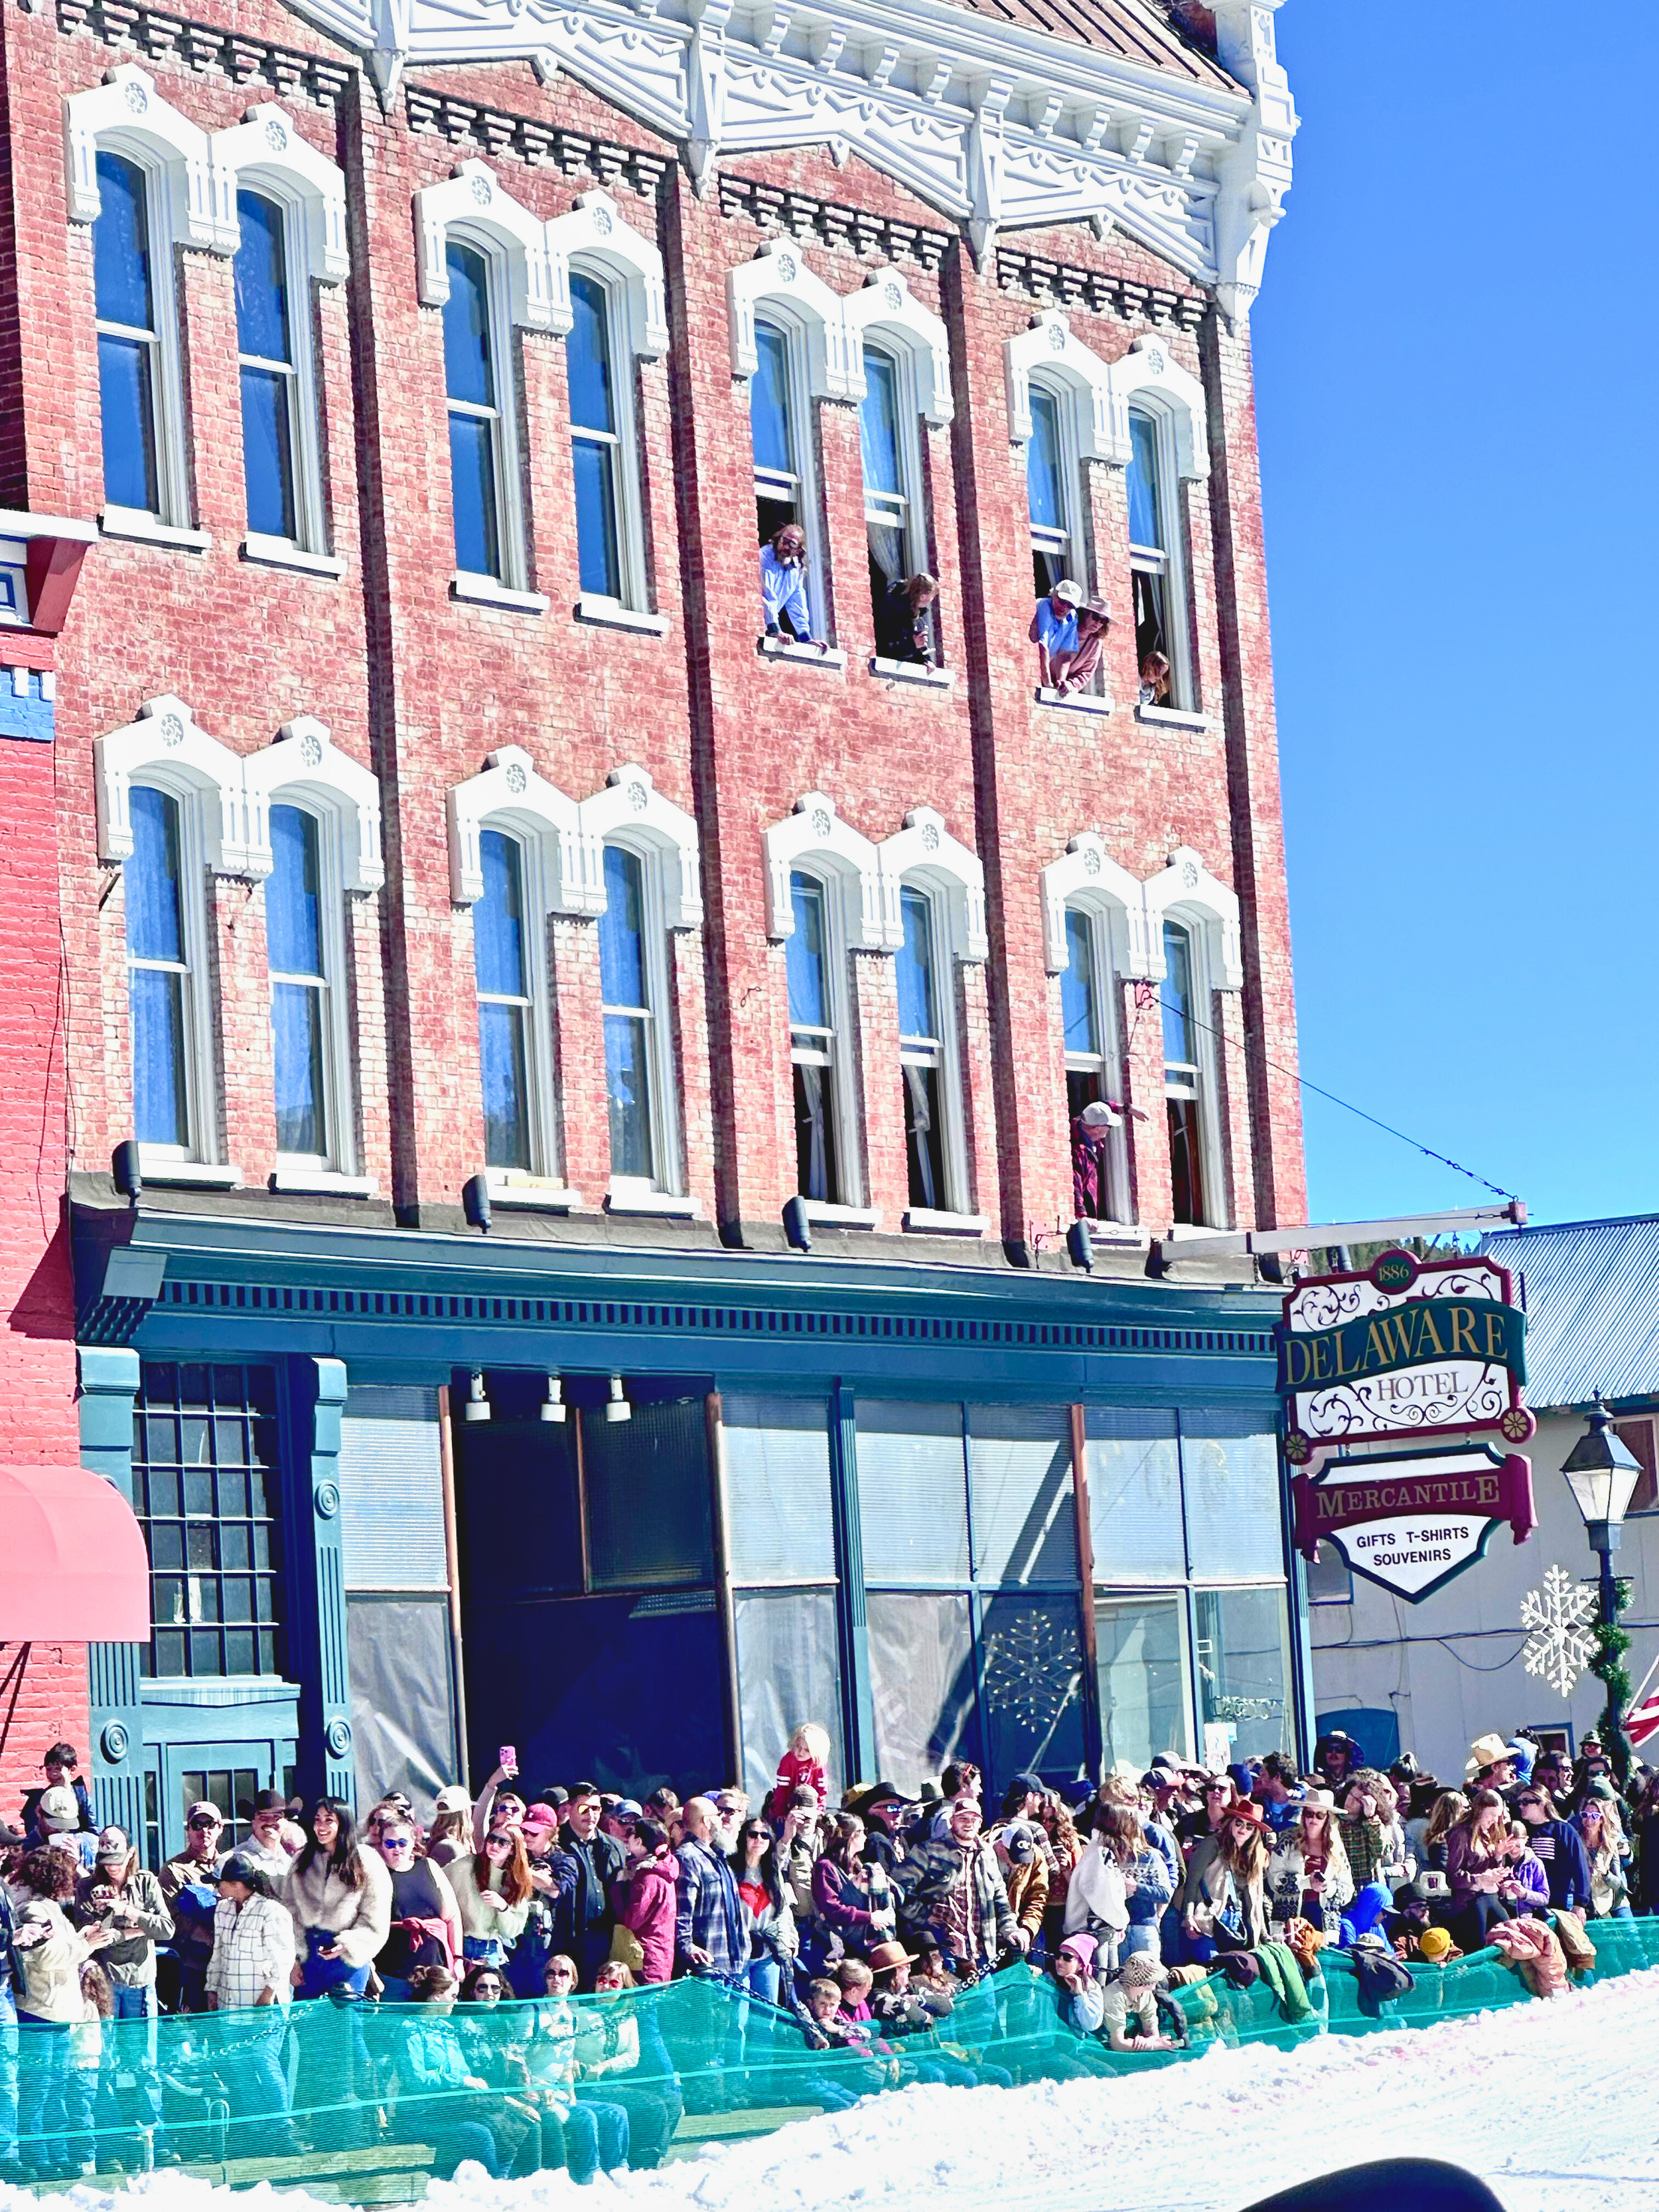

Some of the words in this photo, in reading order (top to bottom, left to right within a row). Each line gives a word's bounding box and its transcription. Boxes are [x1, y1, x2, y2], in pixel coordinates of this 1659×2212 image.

[1378, 1264, 1409, 1282] 1886
[1284, 1307, 1508, 1384] DELAWARE
[1376, 1372, 1469, 1401] HOTEL
[1316, 1476, 1500, 1518] MERCANTILE
[1356, 1533, 1396, 1548] GIFTS
[1406, 1526, 1469, 1543] T-SHIRTS
[1374, 1548, 1451, 1566] SOUVENIRS
